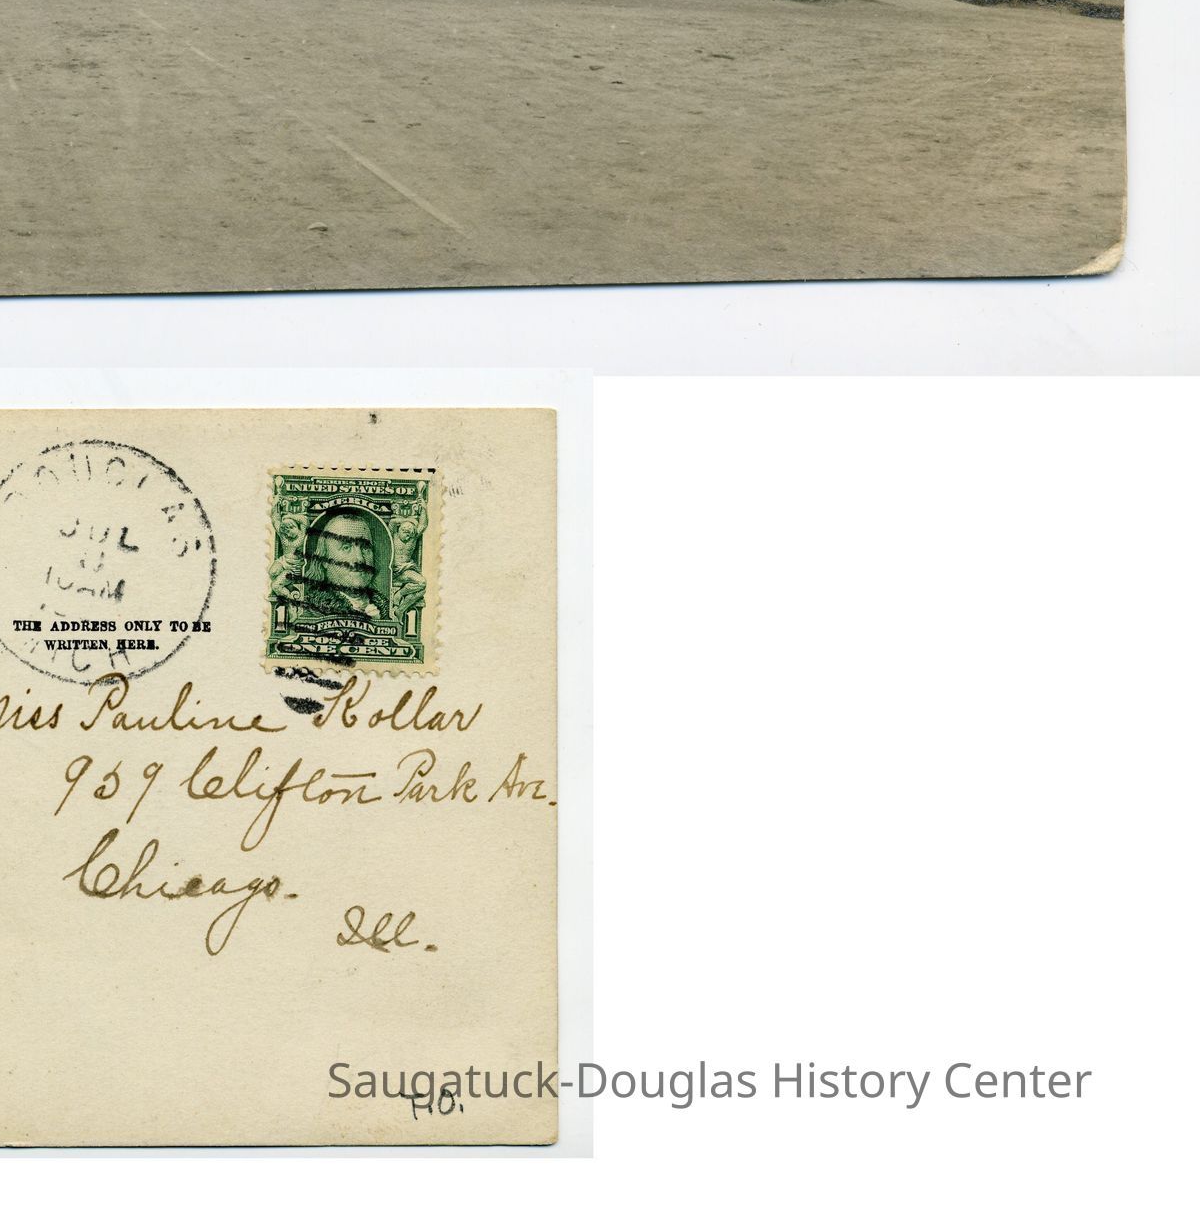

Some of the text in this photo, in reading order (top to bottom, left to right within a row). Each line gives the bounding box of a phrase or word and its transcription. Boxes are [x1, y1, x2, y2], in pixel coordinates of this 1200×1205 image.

[285, 482, 417, 495] UNITED STATES OF
[310, 496, 392, 512] AMERICA
[13, 620, 212, 632] THE ADDRESS ONLY TO BE
[275, 606, 287, 632] 1
[406, 609, 418, 637] 1
[317, 619, 377, 633] FRANKLIN
[377, 625, 397, 636] 1790
[44, 639, 160, 651] WRITTEN HERE.
[300, 635, 390, 646] POSGE
[340, 645, 410, 656] CENT
[80, 672, 288, 733] Pauline
[312, 674, 484, 732] Kollar
[180, 746, 382, 852] Clifton
[393, 748, 479, 804] Park
